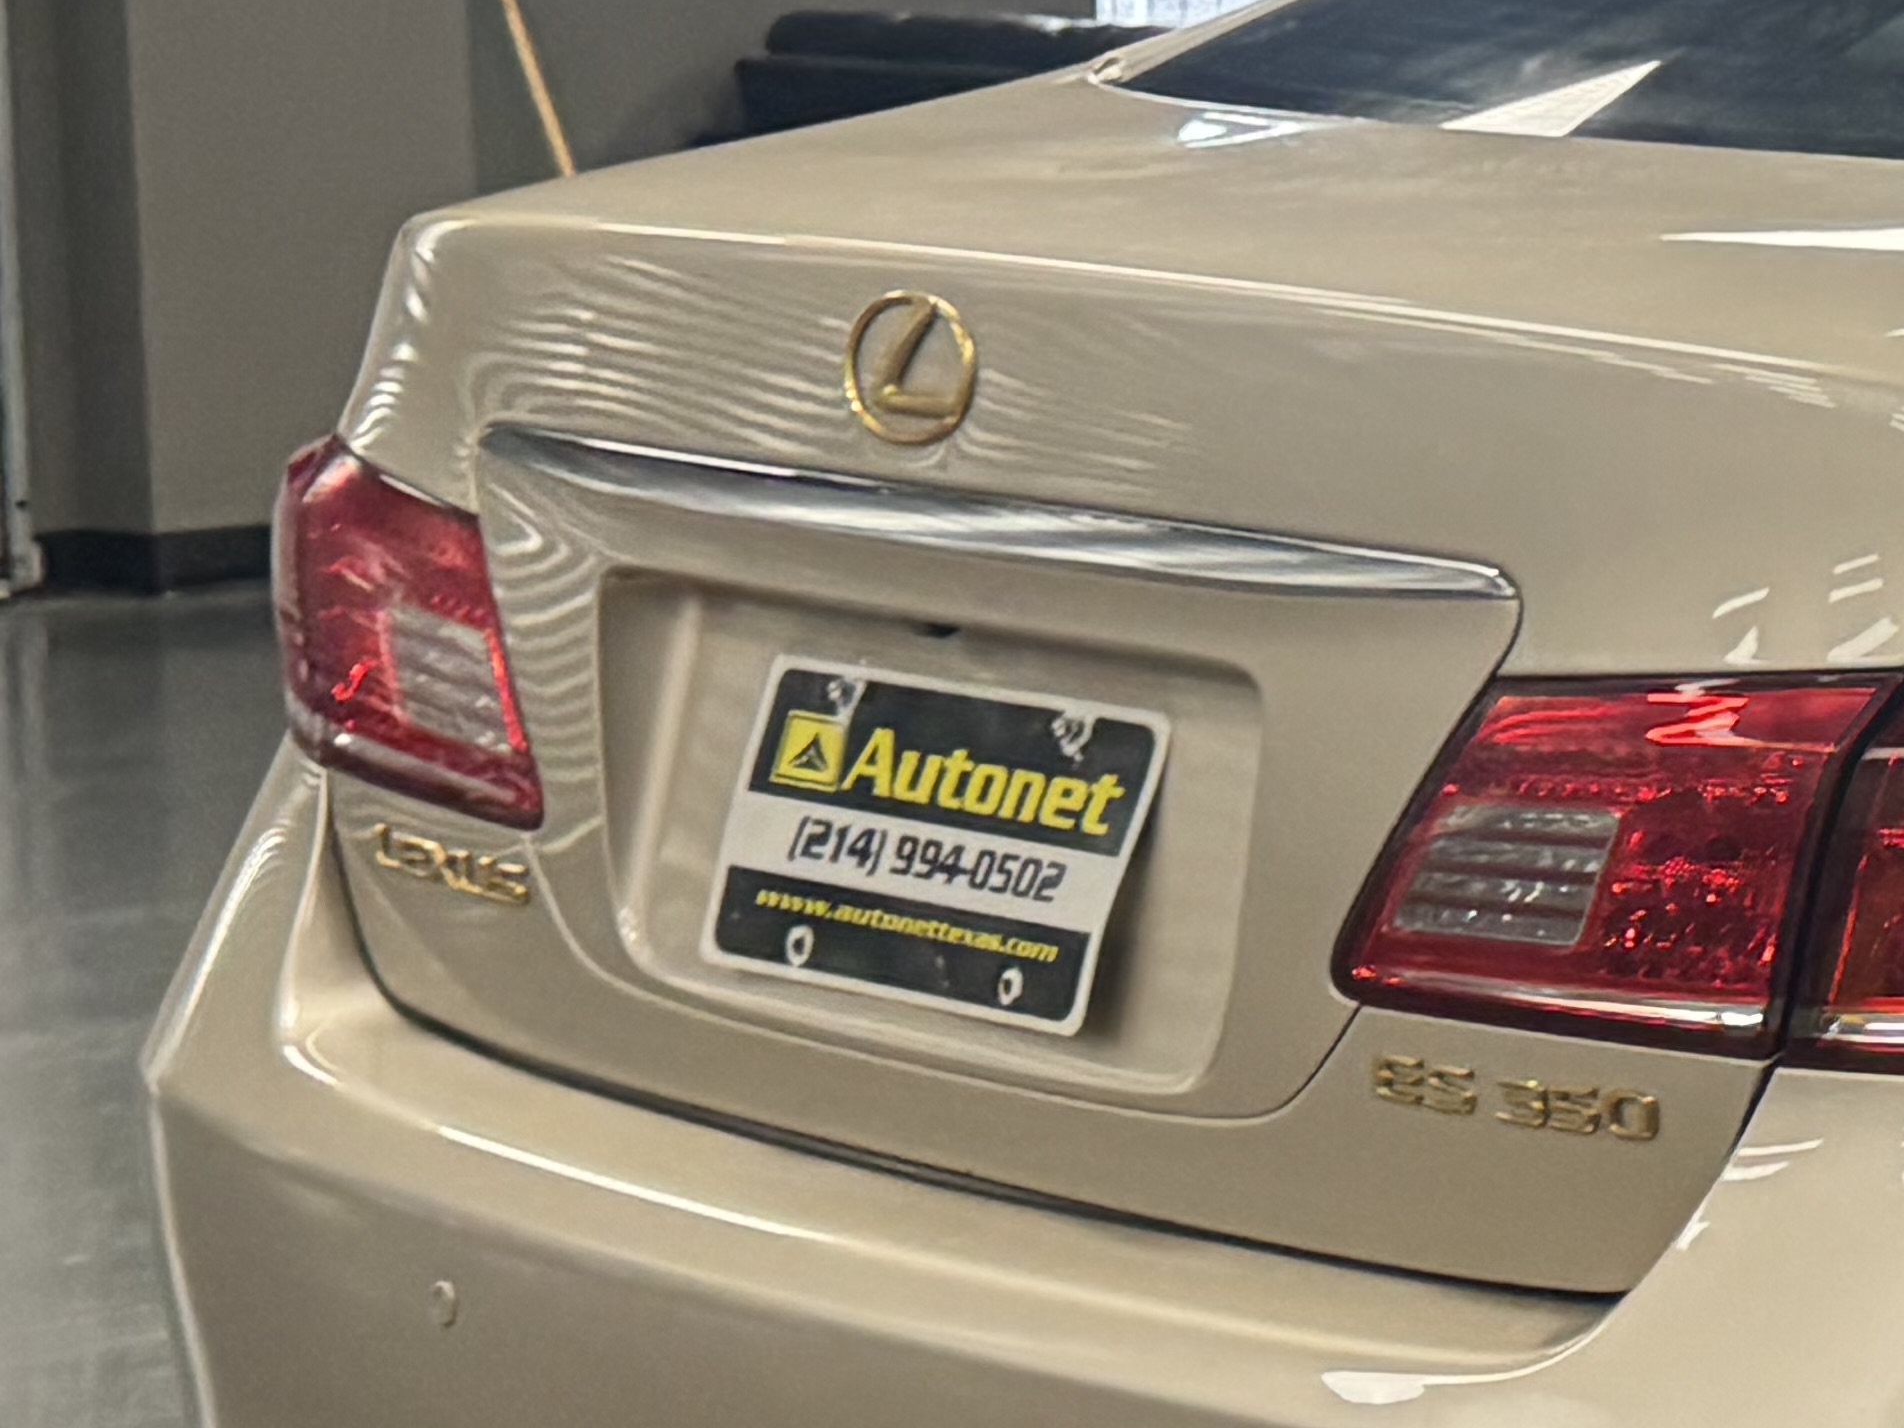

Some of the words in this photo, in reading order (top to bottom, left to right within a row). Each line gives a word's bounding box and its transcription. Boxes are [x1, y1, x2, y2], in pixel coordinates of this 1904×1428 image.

[840, 728, 1125, 836] Autonet
[787, 816, 887, 877] (214)
[888, 835, 1067, 902] 994-0502
[755, 889, 1059, 962] www.autonettexas.com
[1375, 1054, 1478, 1115] ES
[1495, 1079, 1660, 1141] 350
